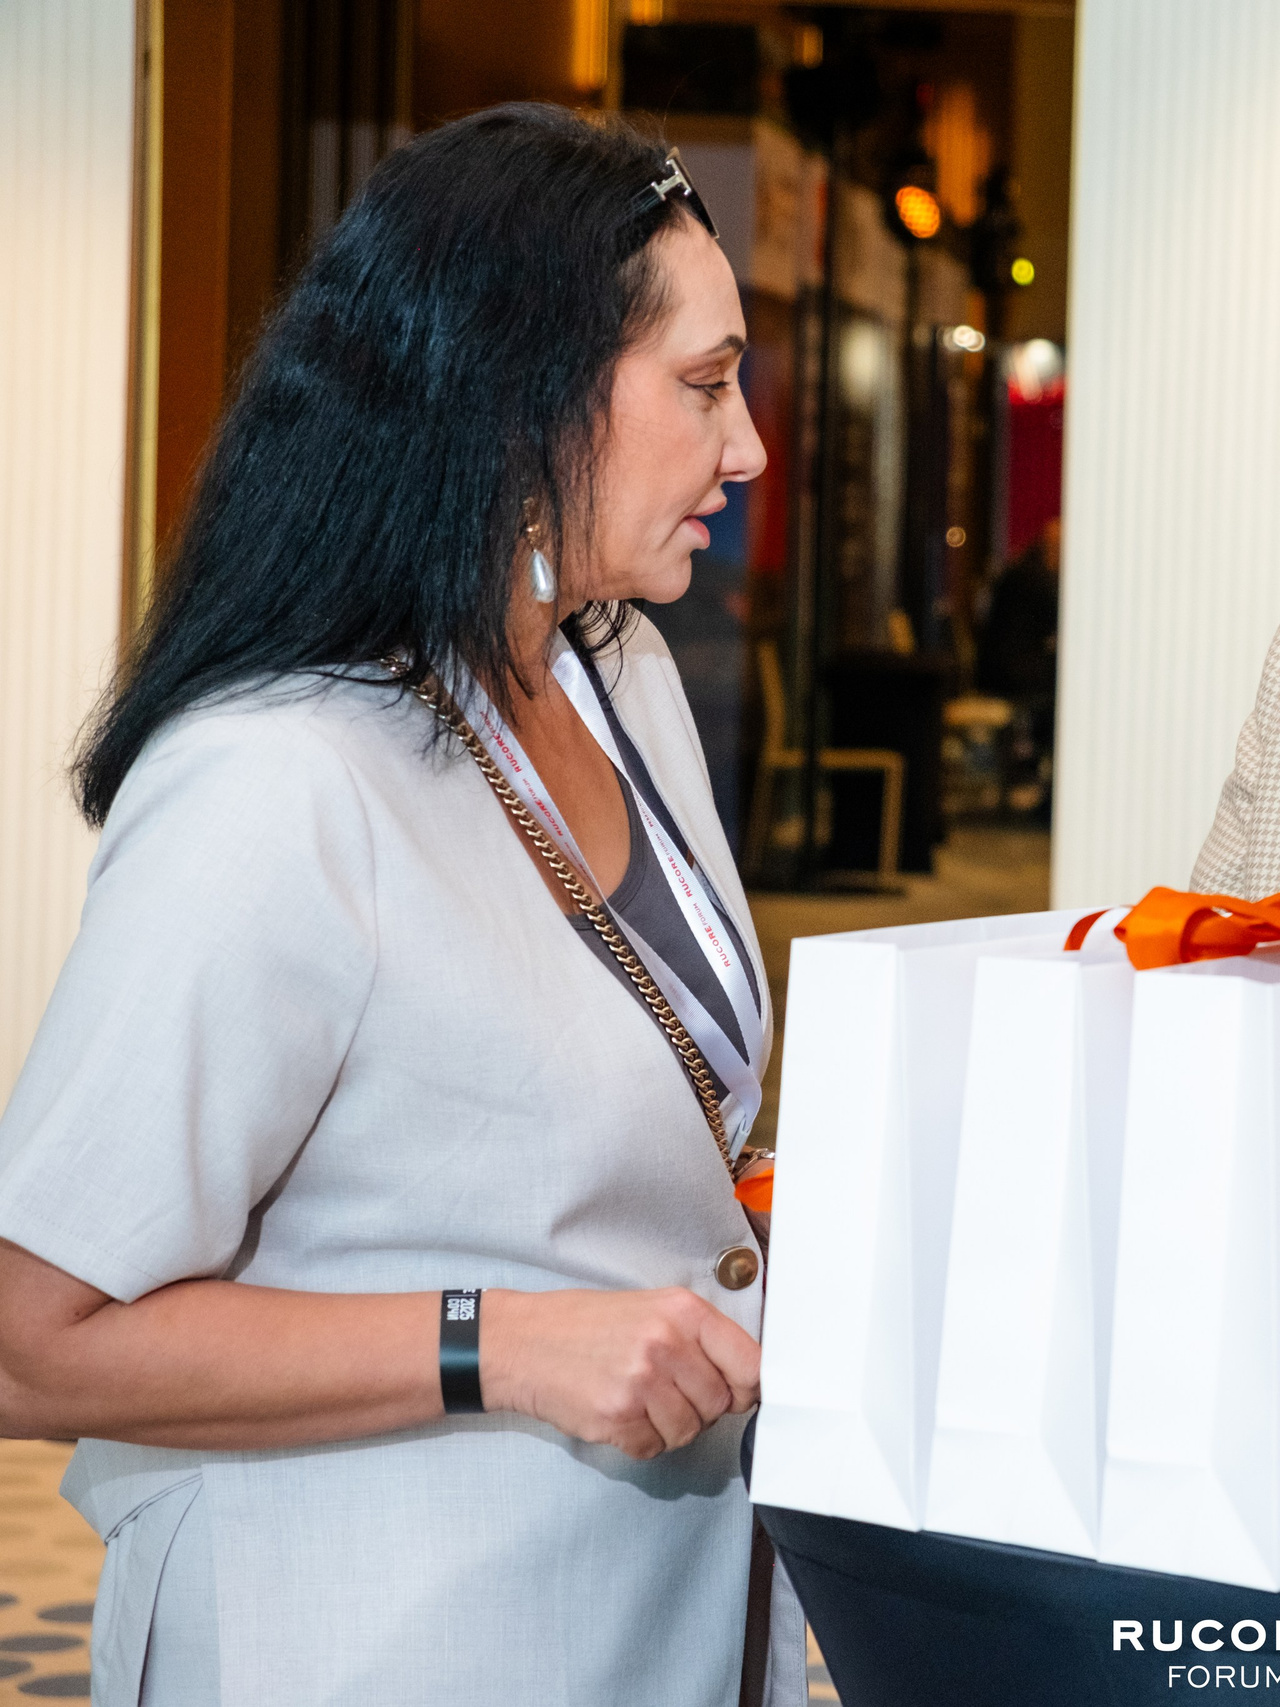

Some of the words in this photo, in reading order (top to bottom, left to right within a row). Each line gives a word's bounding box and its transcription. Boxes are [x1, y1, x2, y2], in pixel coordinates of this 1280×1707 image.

[493, 732, 522, 773] RUCORE
[535, 799, 564, 837] RUCORE
[667, 855, 693, 898] RUCORE
[704, 925, 731, 968] RUCORE
[460, 1298, 475, 1321] 2025
